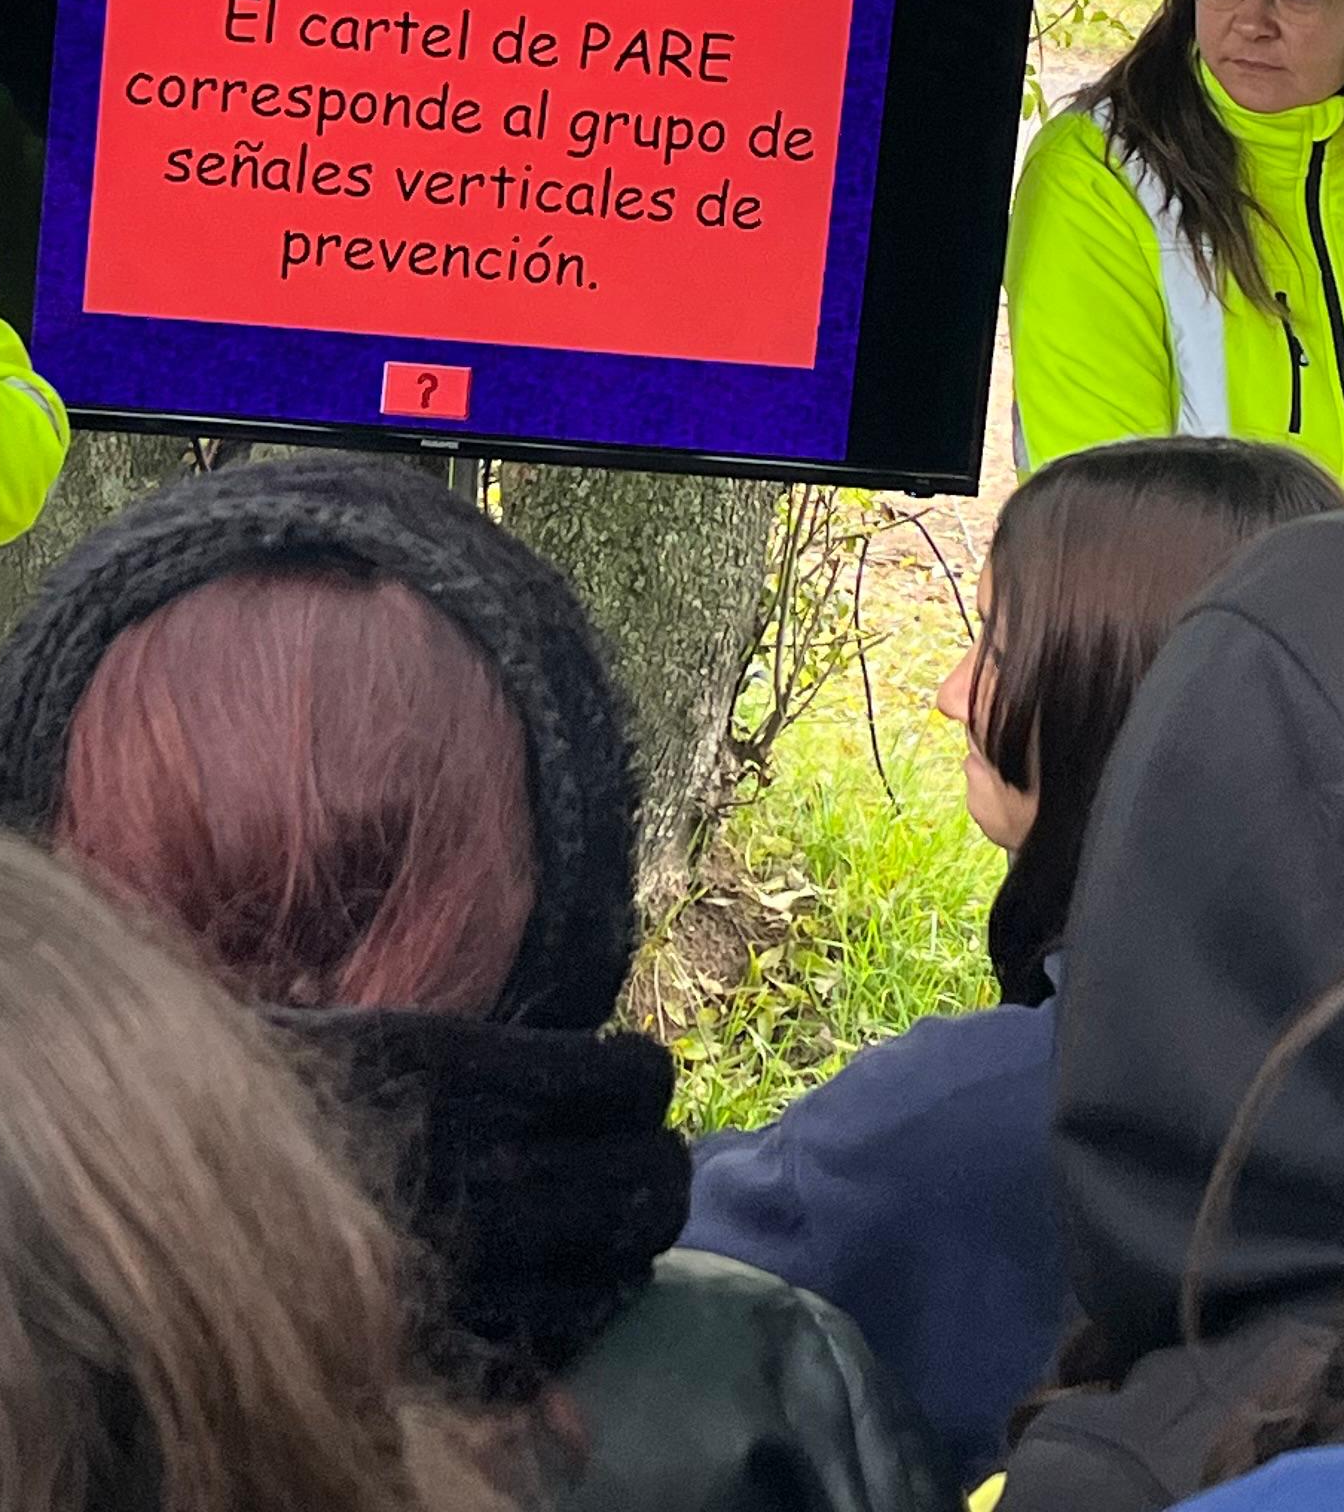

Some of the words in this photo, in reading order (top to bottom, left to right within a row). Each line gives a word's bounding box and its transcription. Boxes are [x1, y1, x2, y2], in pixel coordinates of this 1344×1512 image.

[300, 10, 469, 59] cartel
[493, 16, 557, 67] de
[581, 23, 734, 82] PARE
[127, 73, 481, 136] corresponde
[504, 89, 548, 139] al
[568, 111, 724, 165] grupo
[749, 110, 813, 161] de
[165, 141, 372, 197] señales
[397, 166, 675, 221] verticales
[697, 179, 761, 229] de
[282, 231, 596, 289] prevención.
[418, 372, 439, 409] ?
